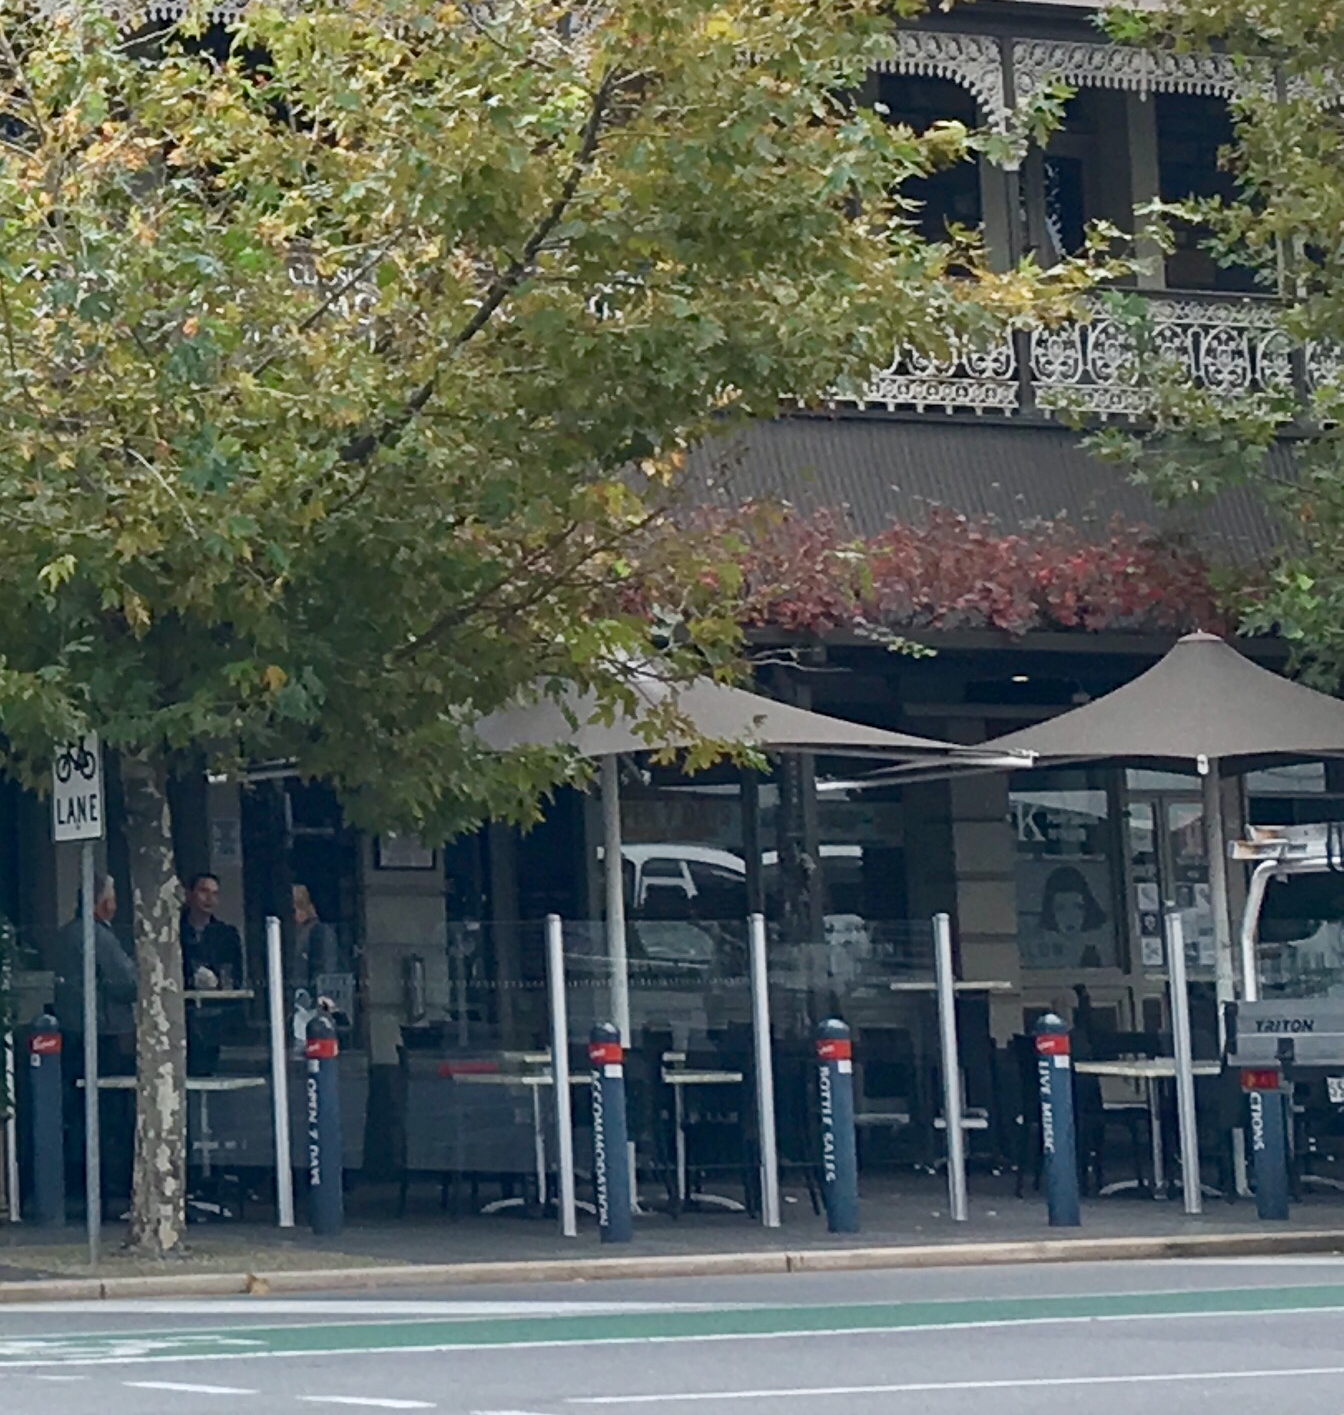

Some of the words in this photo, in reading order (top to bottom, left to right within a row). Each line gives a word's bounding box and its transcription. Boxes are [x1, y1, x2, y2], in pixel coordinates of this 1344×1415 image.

[57, 794, 98, 825] LANE
[1255, 1019, 1314, 1033] TRITON
[307, 1078, 318, 1123] OPEN
[819, 1066, 833, 1126] BOTTLE
[1038, 1061, 1051, 1095] LIVE
[309, 1129, 319, 1140] 7
[1042, 1101, 1055, 1154] MUSIC
[1249, 1092, 1265, 1151] CTIONS
[309, 1145, 321, 1185] DAYS
[591, 1069, 609, 1226] ACCOMMODATION
[823, 1133, 836, 1182] SALES
